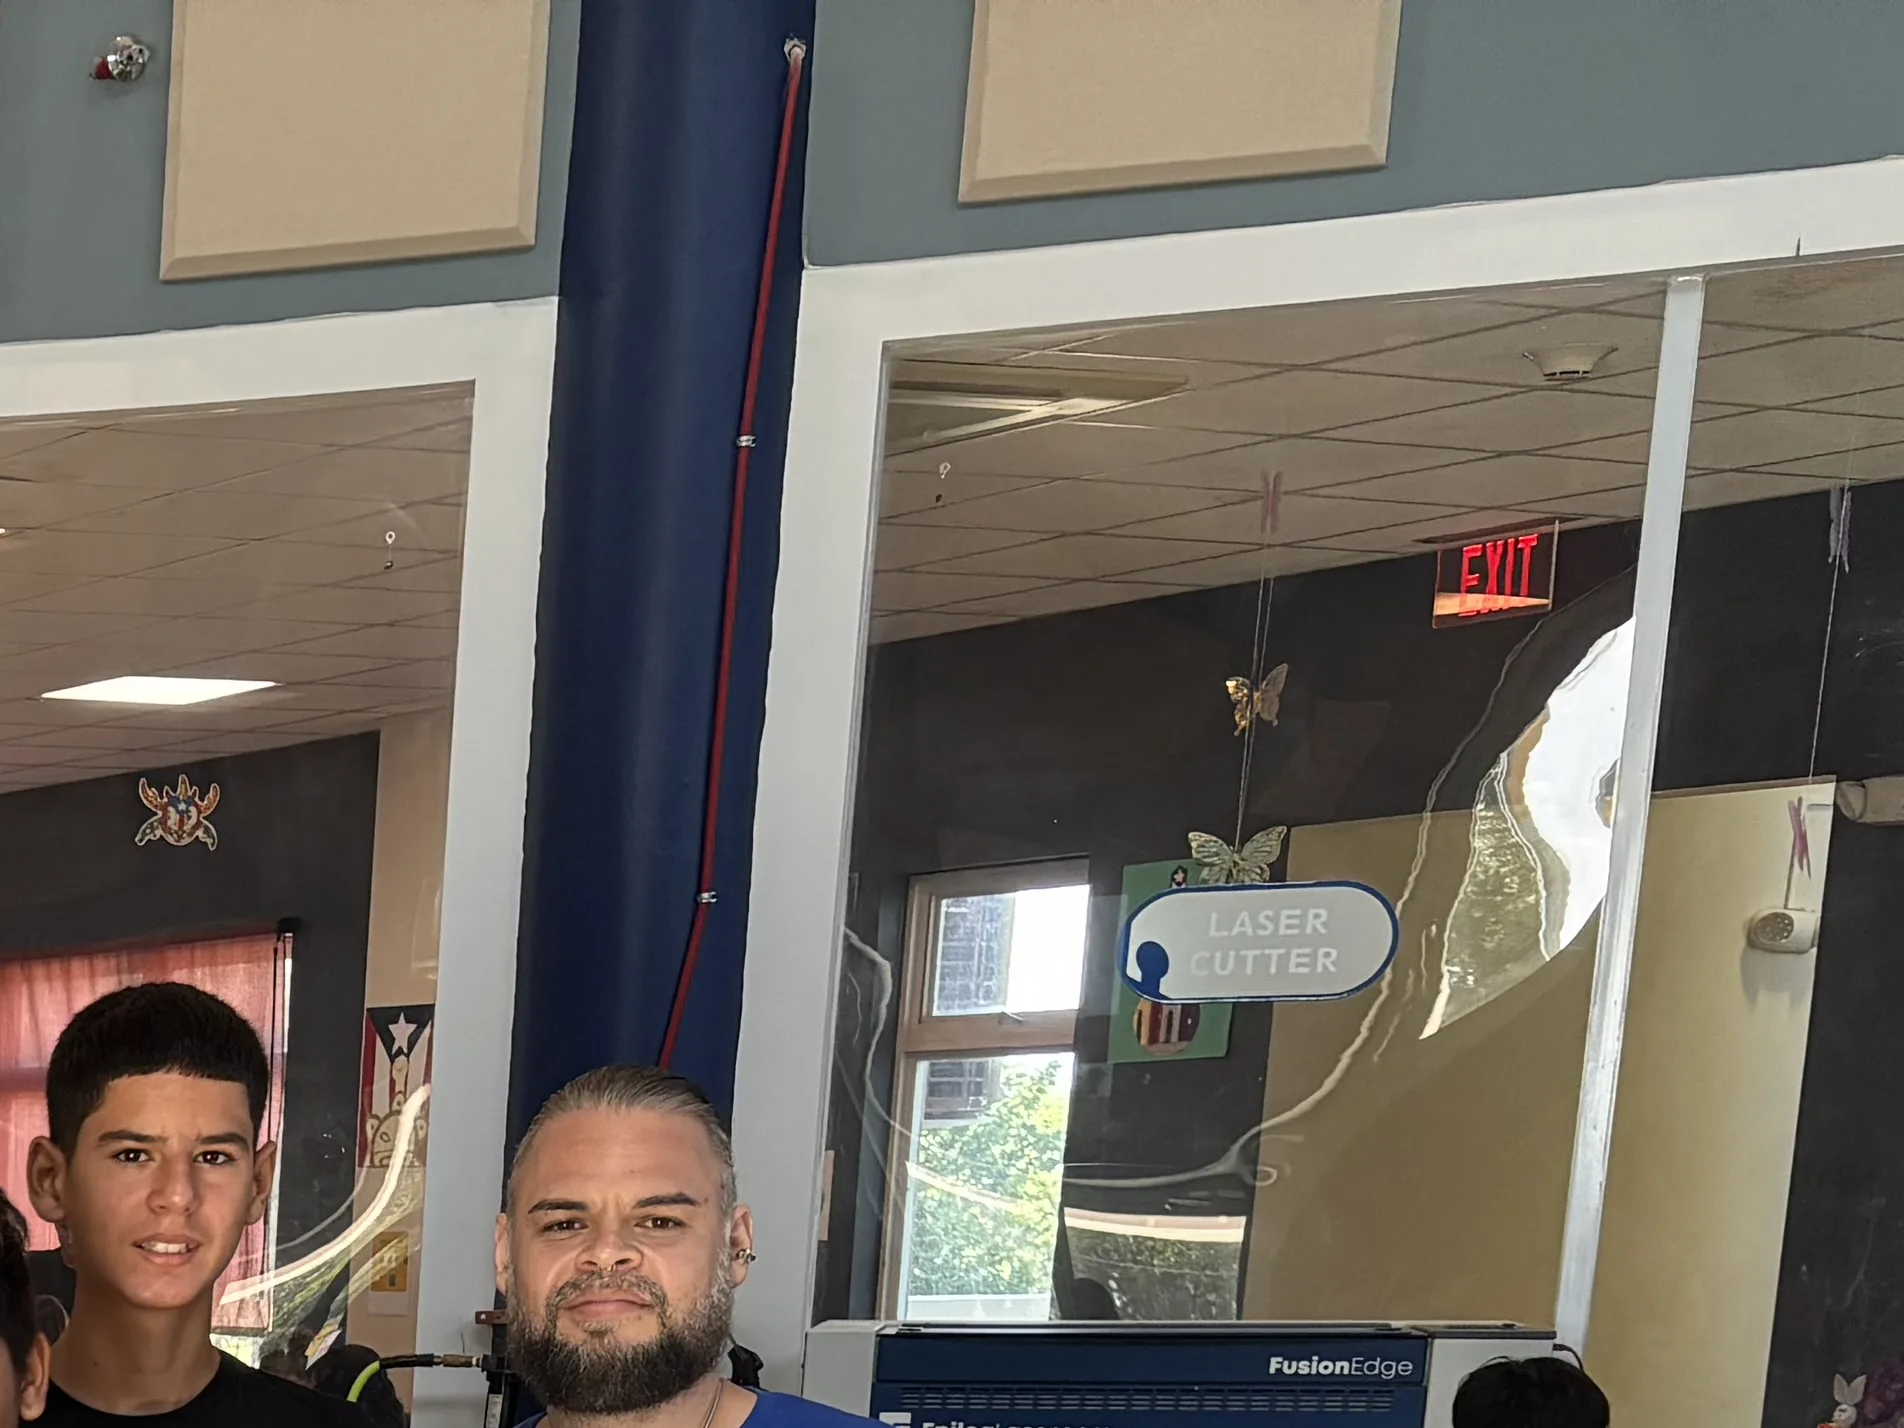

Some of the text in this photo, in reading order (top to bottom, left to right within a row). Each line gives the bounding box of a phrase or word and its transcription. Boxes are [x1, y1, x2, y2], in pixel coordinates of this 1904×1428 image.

[1458, 533, 1539, 617] EXIT
[1208, 908, 1328, 937] LASER
[1191, 947, 1338, 976] CUTTER
[1269, 1355, 1413, 1379] FusionEdge
